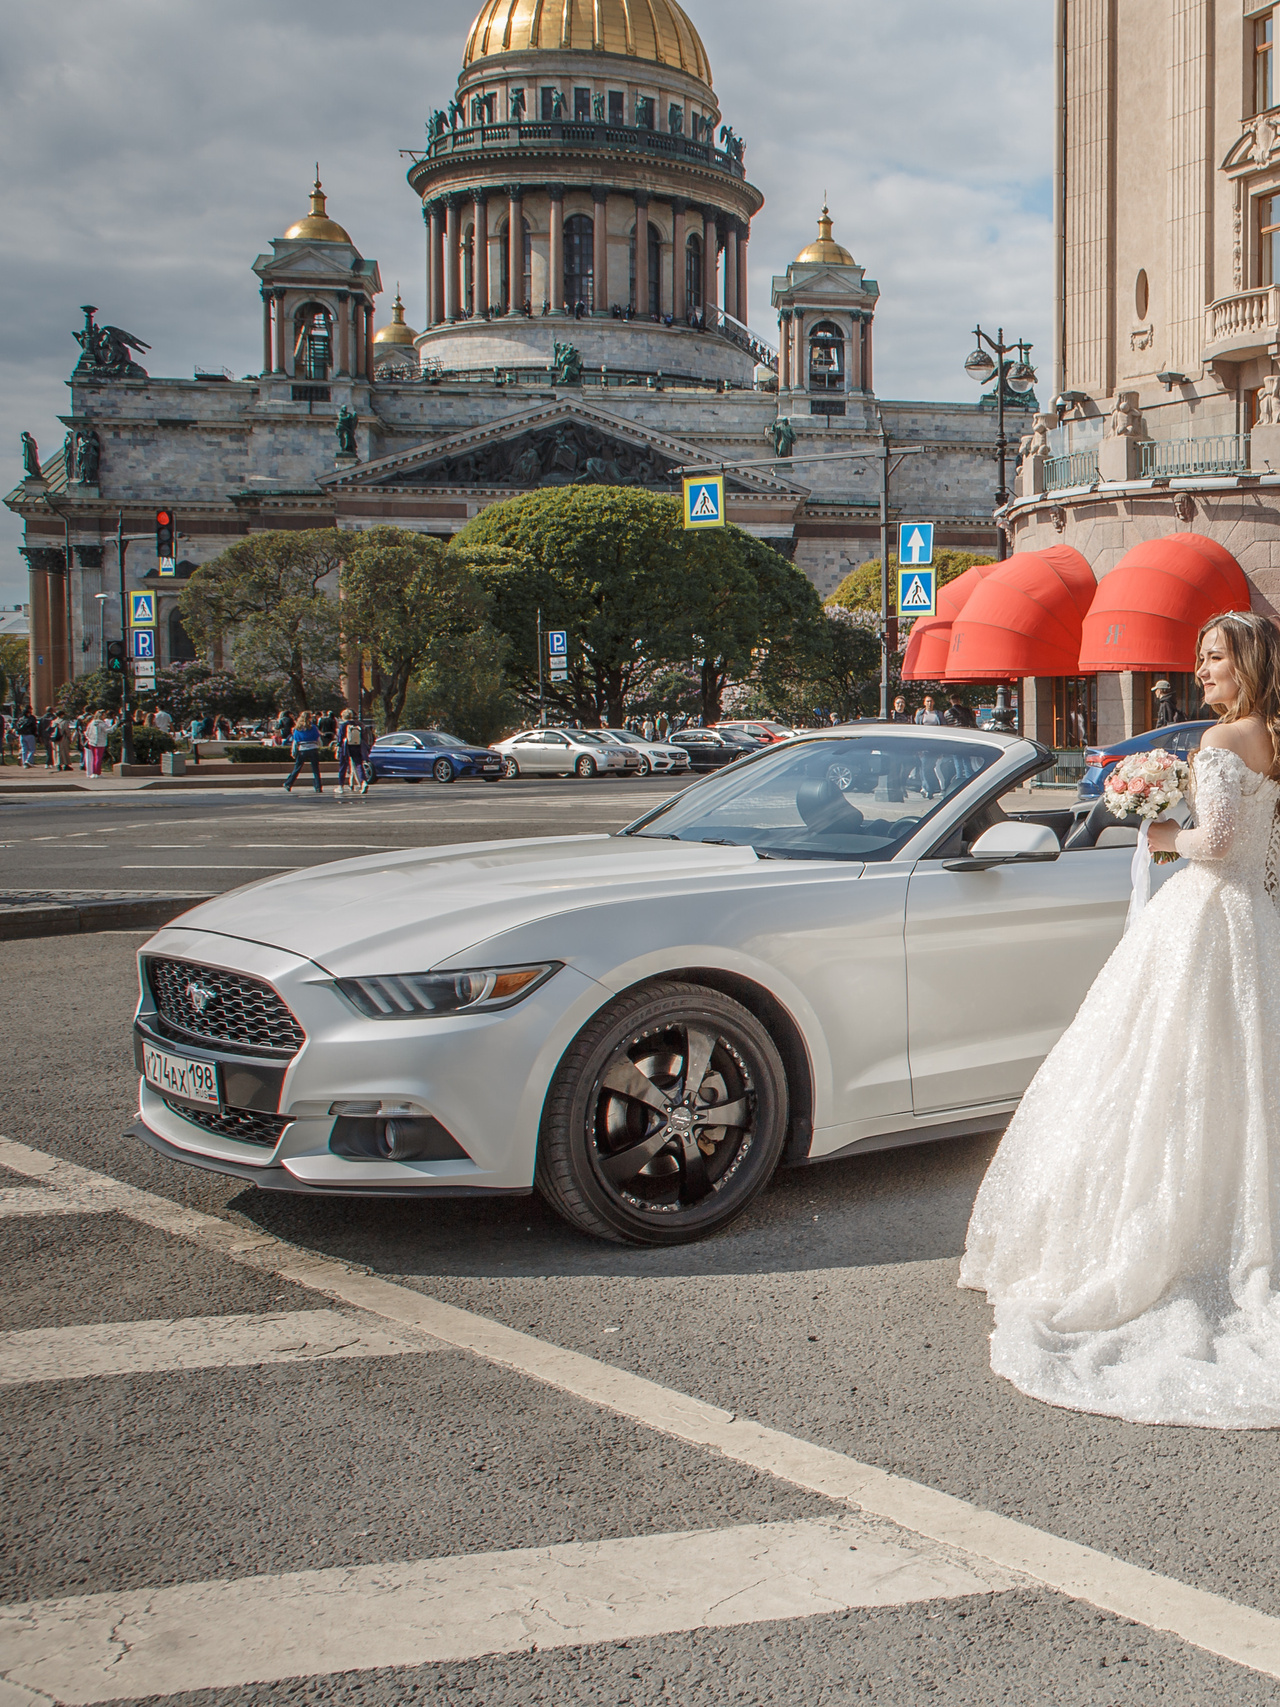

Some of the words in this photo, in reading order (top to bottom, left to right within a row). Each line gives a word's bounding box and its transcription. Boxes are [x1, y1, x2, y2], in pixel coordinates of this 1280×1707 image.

[138, 633, 150, 655] P
[553, 634, 563, 652] P
[189, 1063, 214, 1091] 198
[195, 1088, 209, 1099] RUS
